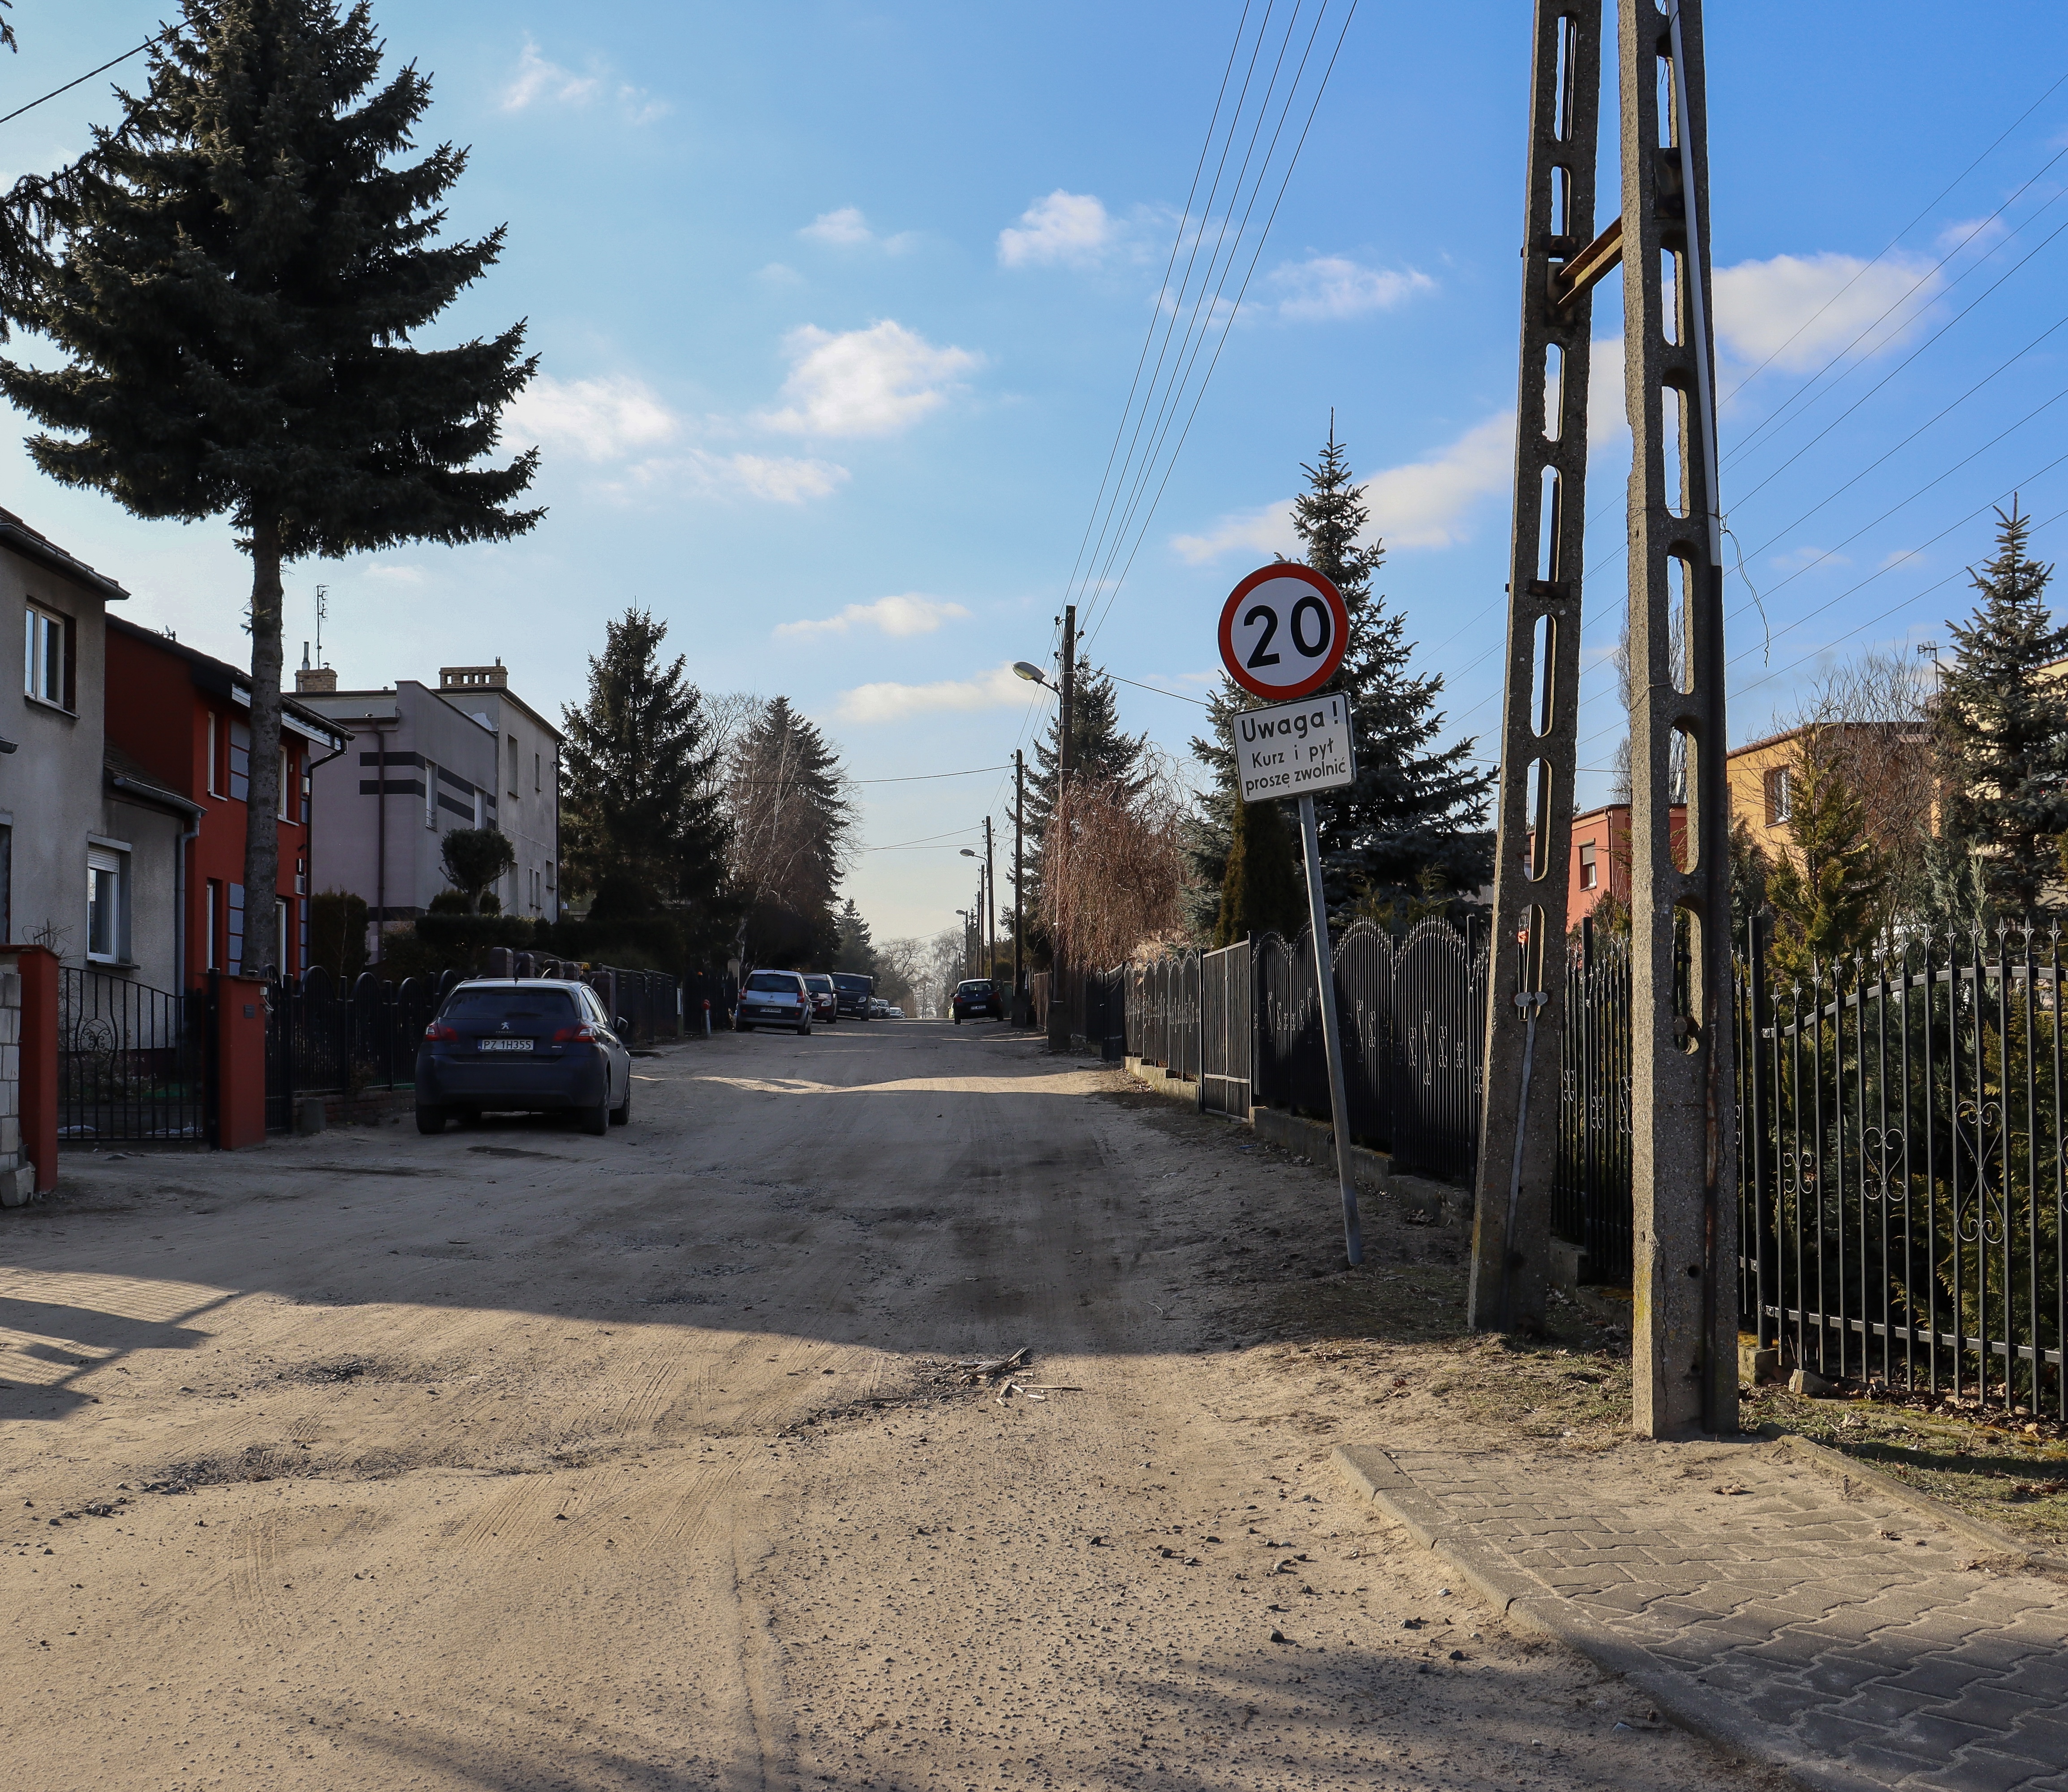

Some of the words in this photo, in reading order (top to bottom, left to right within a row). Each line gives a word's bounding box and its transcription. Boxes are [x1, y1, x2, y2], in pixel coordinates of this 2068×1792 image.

[1243, 596, 1331, 669] 20
[1241, 711, 1325, 742] Uwaga
[1252, 751, 1285, 768] Kurz
[1294, 745, 1298, 760] i
[1309, 737, 1334, 762] pył
[1245, 773, 1290, 796] proszę
[1294, 757, 1346, 782] zwolnić
[484, 1040, 497, 1049] PZ
[501, 1040, 531, 1049] 1H355
